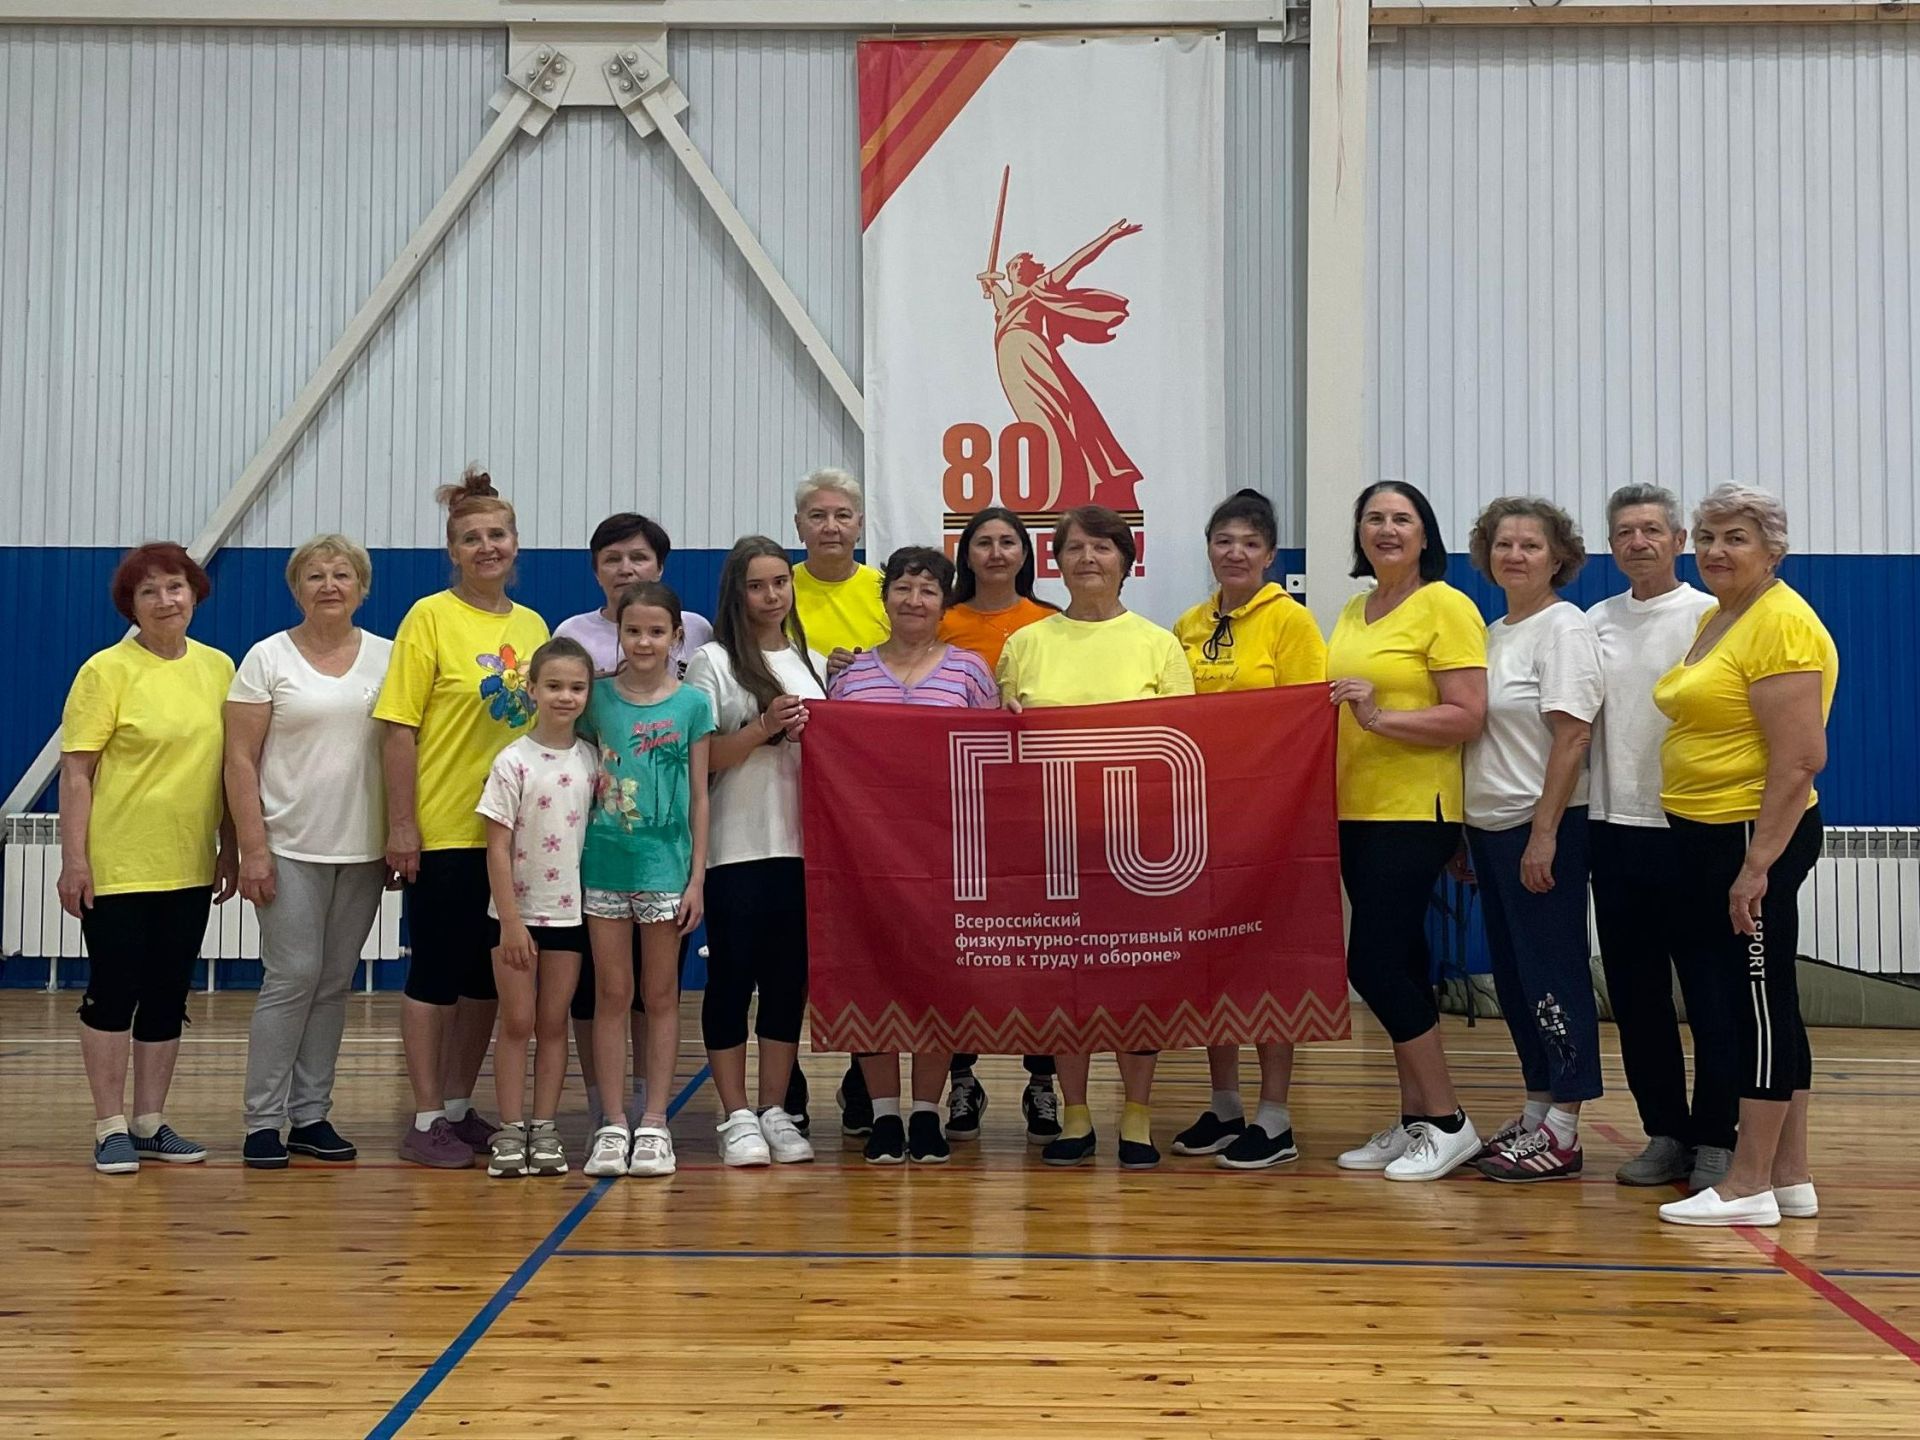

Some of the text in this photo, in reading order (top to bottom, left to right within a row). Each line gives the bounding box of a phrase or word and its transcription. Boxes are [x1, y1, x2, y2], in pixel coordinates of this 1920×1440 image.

[943, 422, 1050, 512] 80
[949, 726, 1209, 901] ГТО
[954, 912, 1081, 931] Всероссийский
[954, 919, 1263, 951] физкультурно-спортивный комплекс
[956, 949, 1181, 969] «Готов к труду и обороне»
[1748, 919, 1765, 979] SPORT
